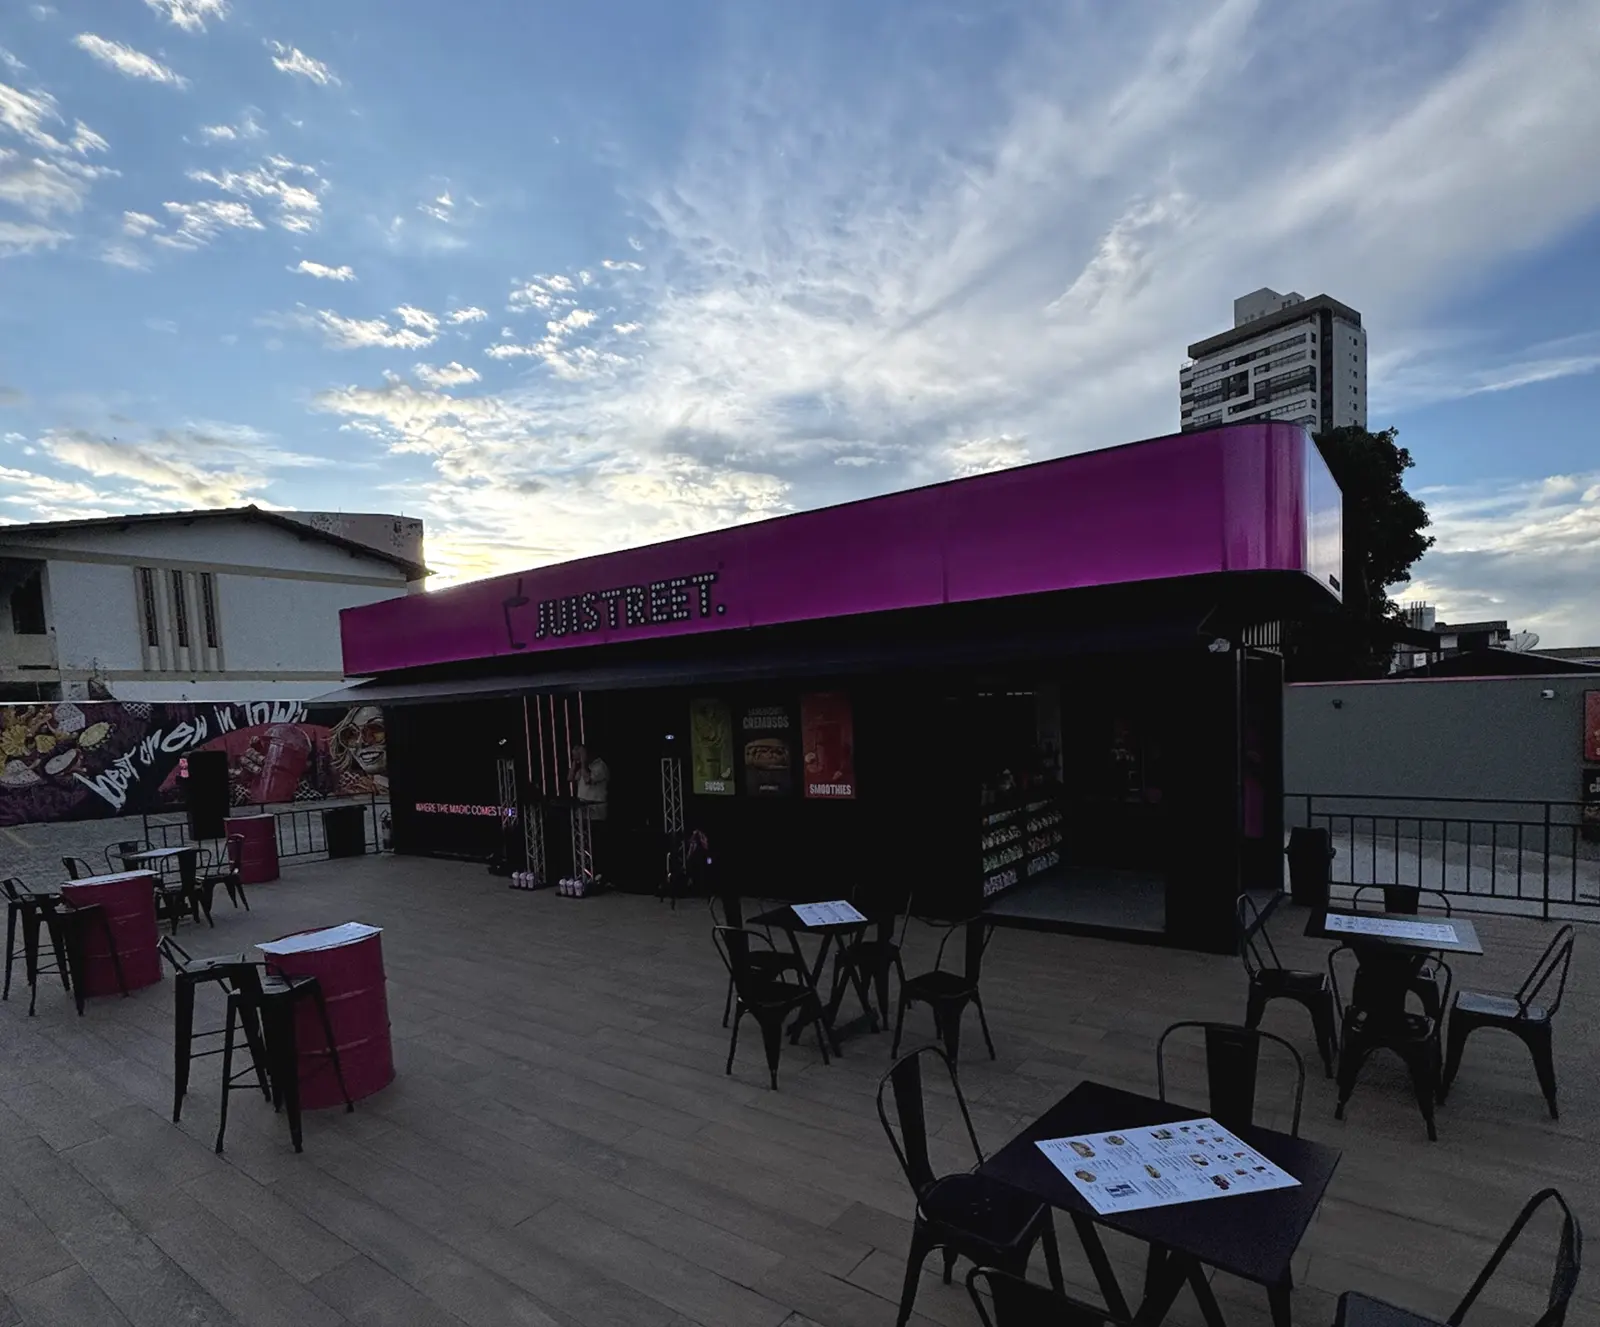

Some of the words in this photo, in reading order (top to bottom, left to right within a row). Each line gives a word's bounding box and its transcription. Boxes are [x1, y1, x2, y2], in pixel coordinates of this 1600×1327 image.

[809, 783, 852, 795] SMOOTHIES
[415, 802, 436, 813] WHERE
[437, 803, 449, 814] THE
[450, 803, 471, 815] MAGIC
[472, 805, 497, 817] COMES
